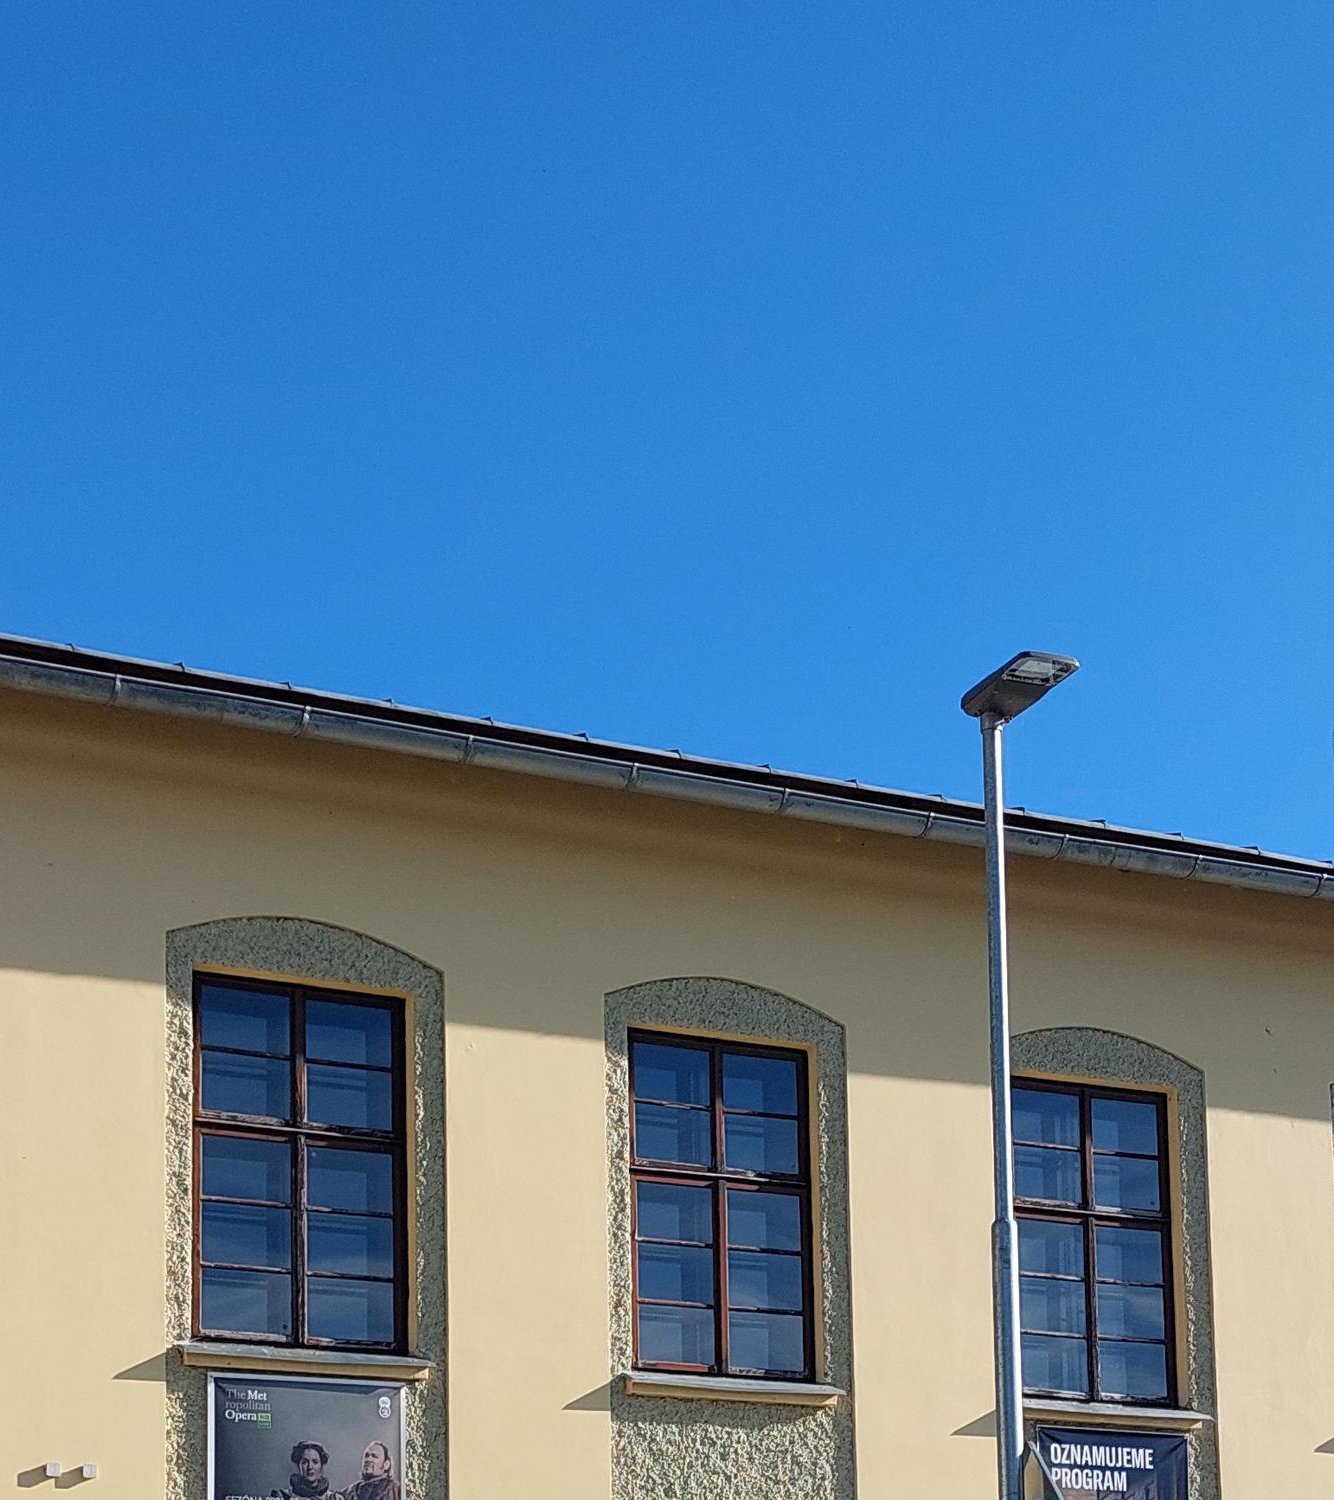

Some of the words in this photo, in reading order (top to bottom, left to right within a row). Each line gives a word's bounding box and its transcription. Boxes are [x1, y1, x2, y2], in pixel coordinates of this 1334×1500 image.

[226, 1389, 246, 1399] The
[247, 1389, 267, 1401] Met
[225, 1409, 257, 1422] Opera
[1050, 1443, 1154, 1469] OZNAMUJEME
[1051, 1467, 1127, 1492] PROGRAM
